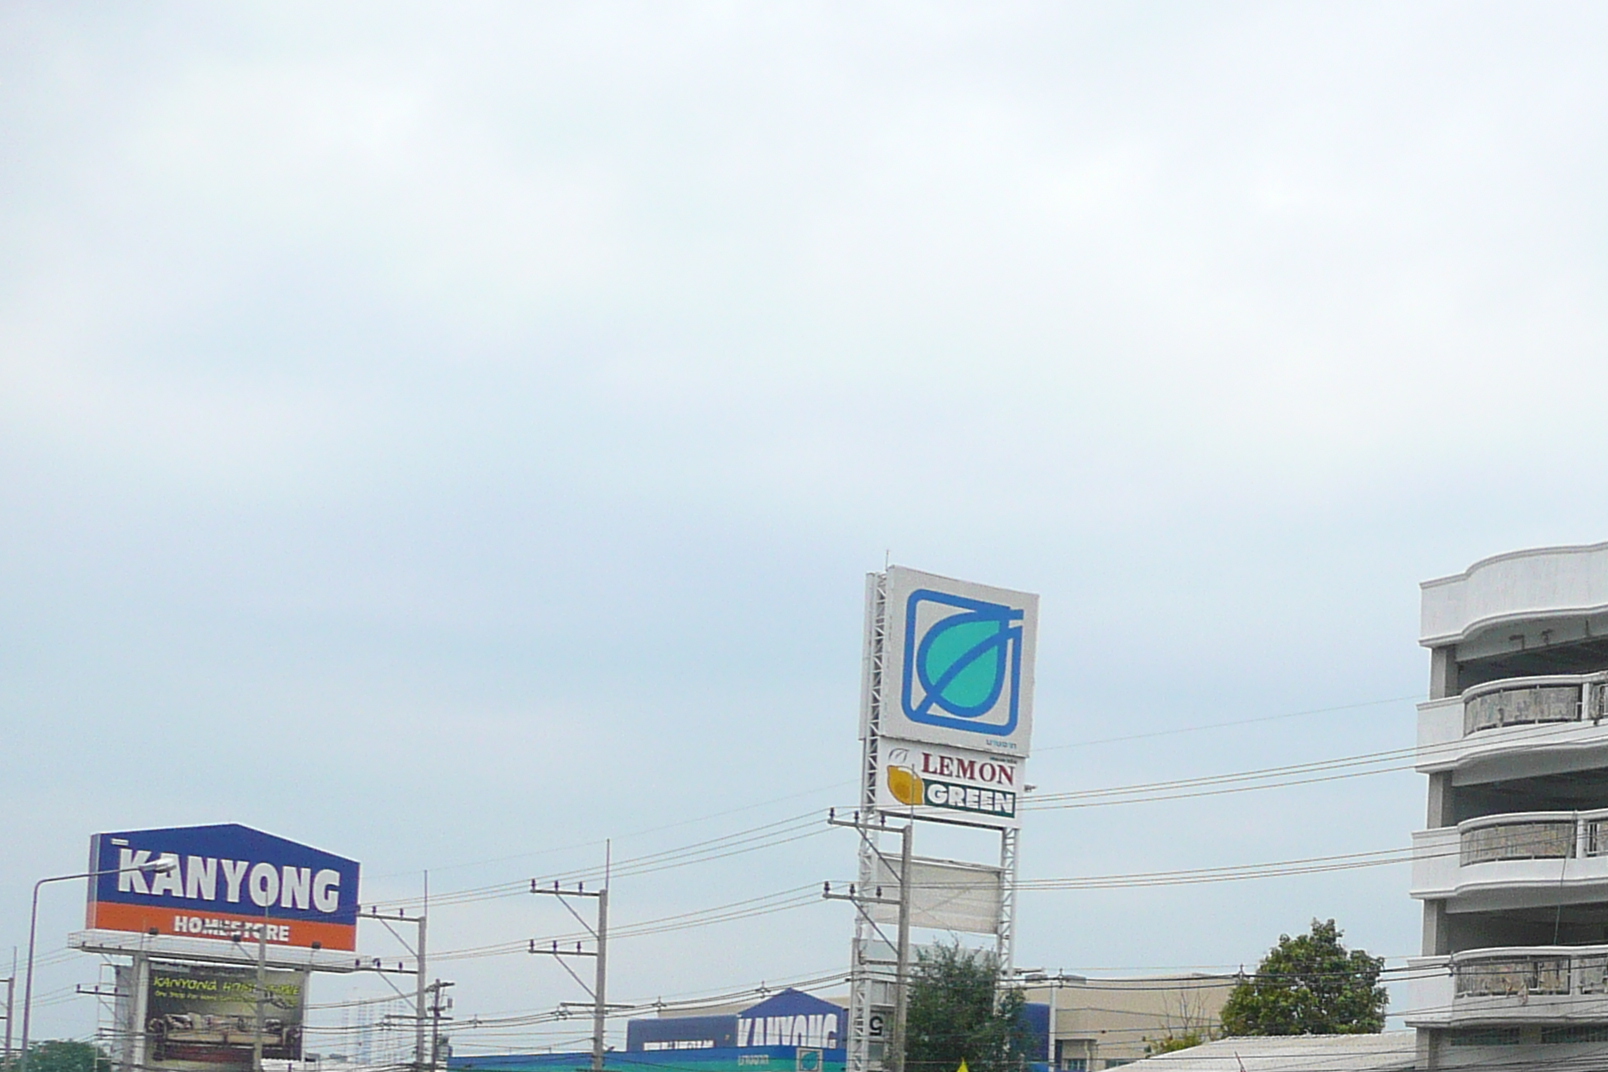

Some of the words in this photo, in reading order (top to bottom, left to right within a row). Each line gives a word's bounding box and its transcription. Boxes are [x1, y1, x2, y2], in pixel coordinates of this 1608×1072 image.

[921, 752, 1015, 786] LEMON
[927, 784, 1013, 814] GREEN
[118, 848, 341, 913] KANYONG
